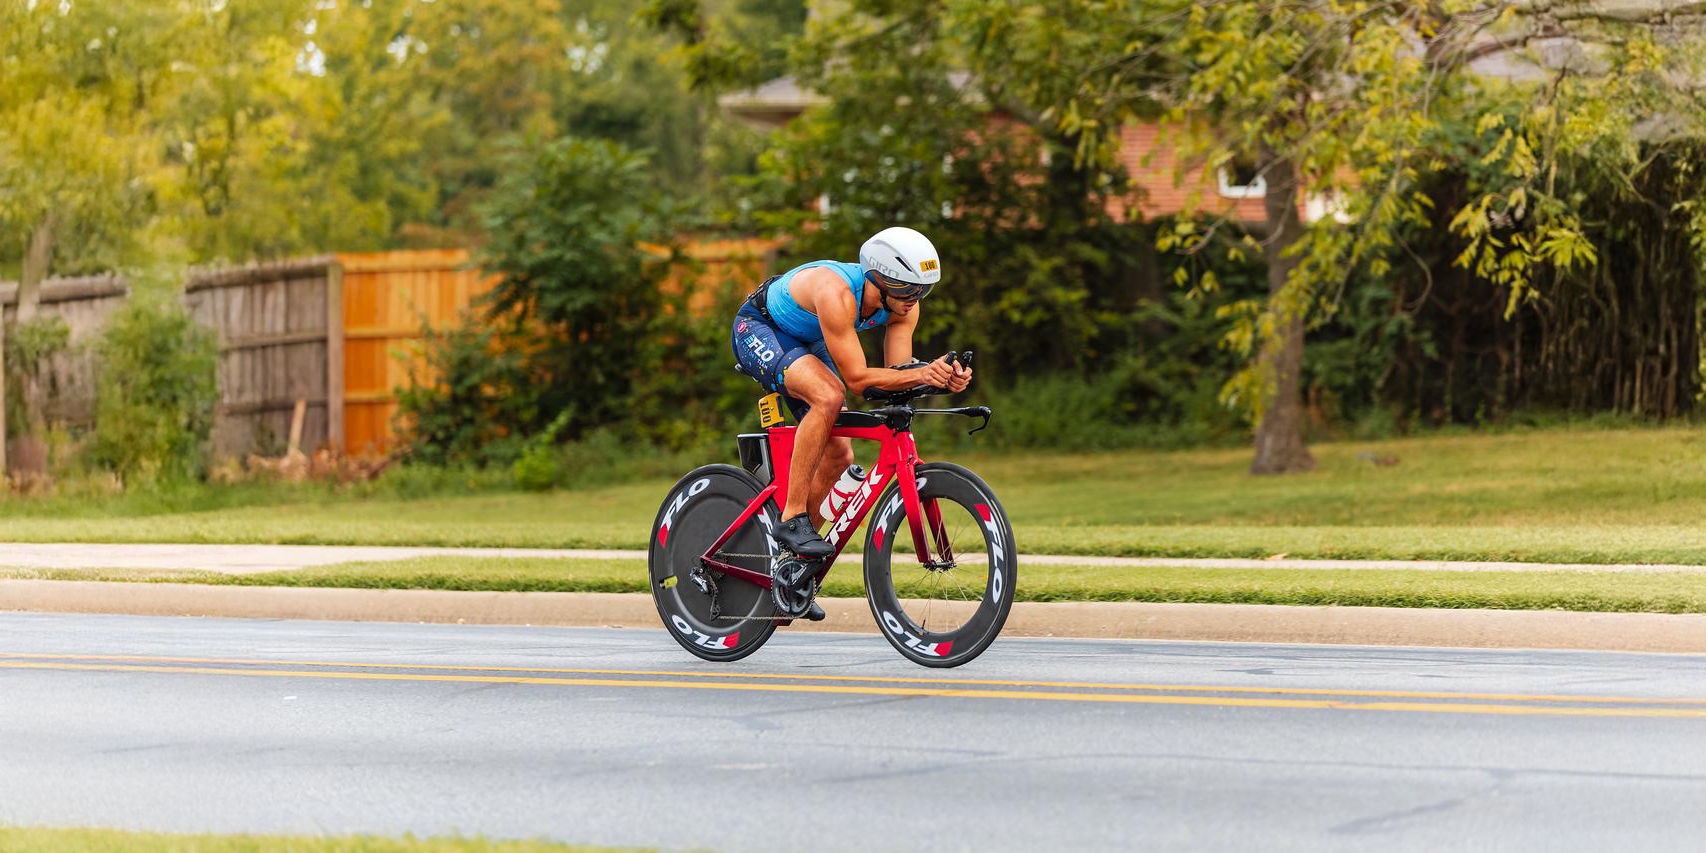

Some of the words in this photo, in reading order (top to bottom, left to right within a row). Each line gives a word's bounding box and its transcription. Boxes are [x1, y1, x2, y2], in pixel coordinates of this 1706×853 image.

[869, 256, 900, 279] GIRO
[748, 336, 775, 363] FLO
[760, 400, 772, 424] 100
[660, 478, 711, 531] FLO
[823, 463, 884, 546] REK
[984, 511, 1004, 604] FLO
[671, 614, 730, 650] FLO
[883, 610, 941, 657] FLO
